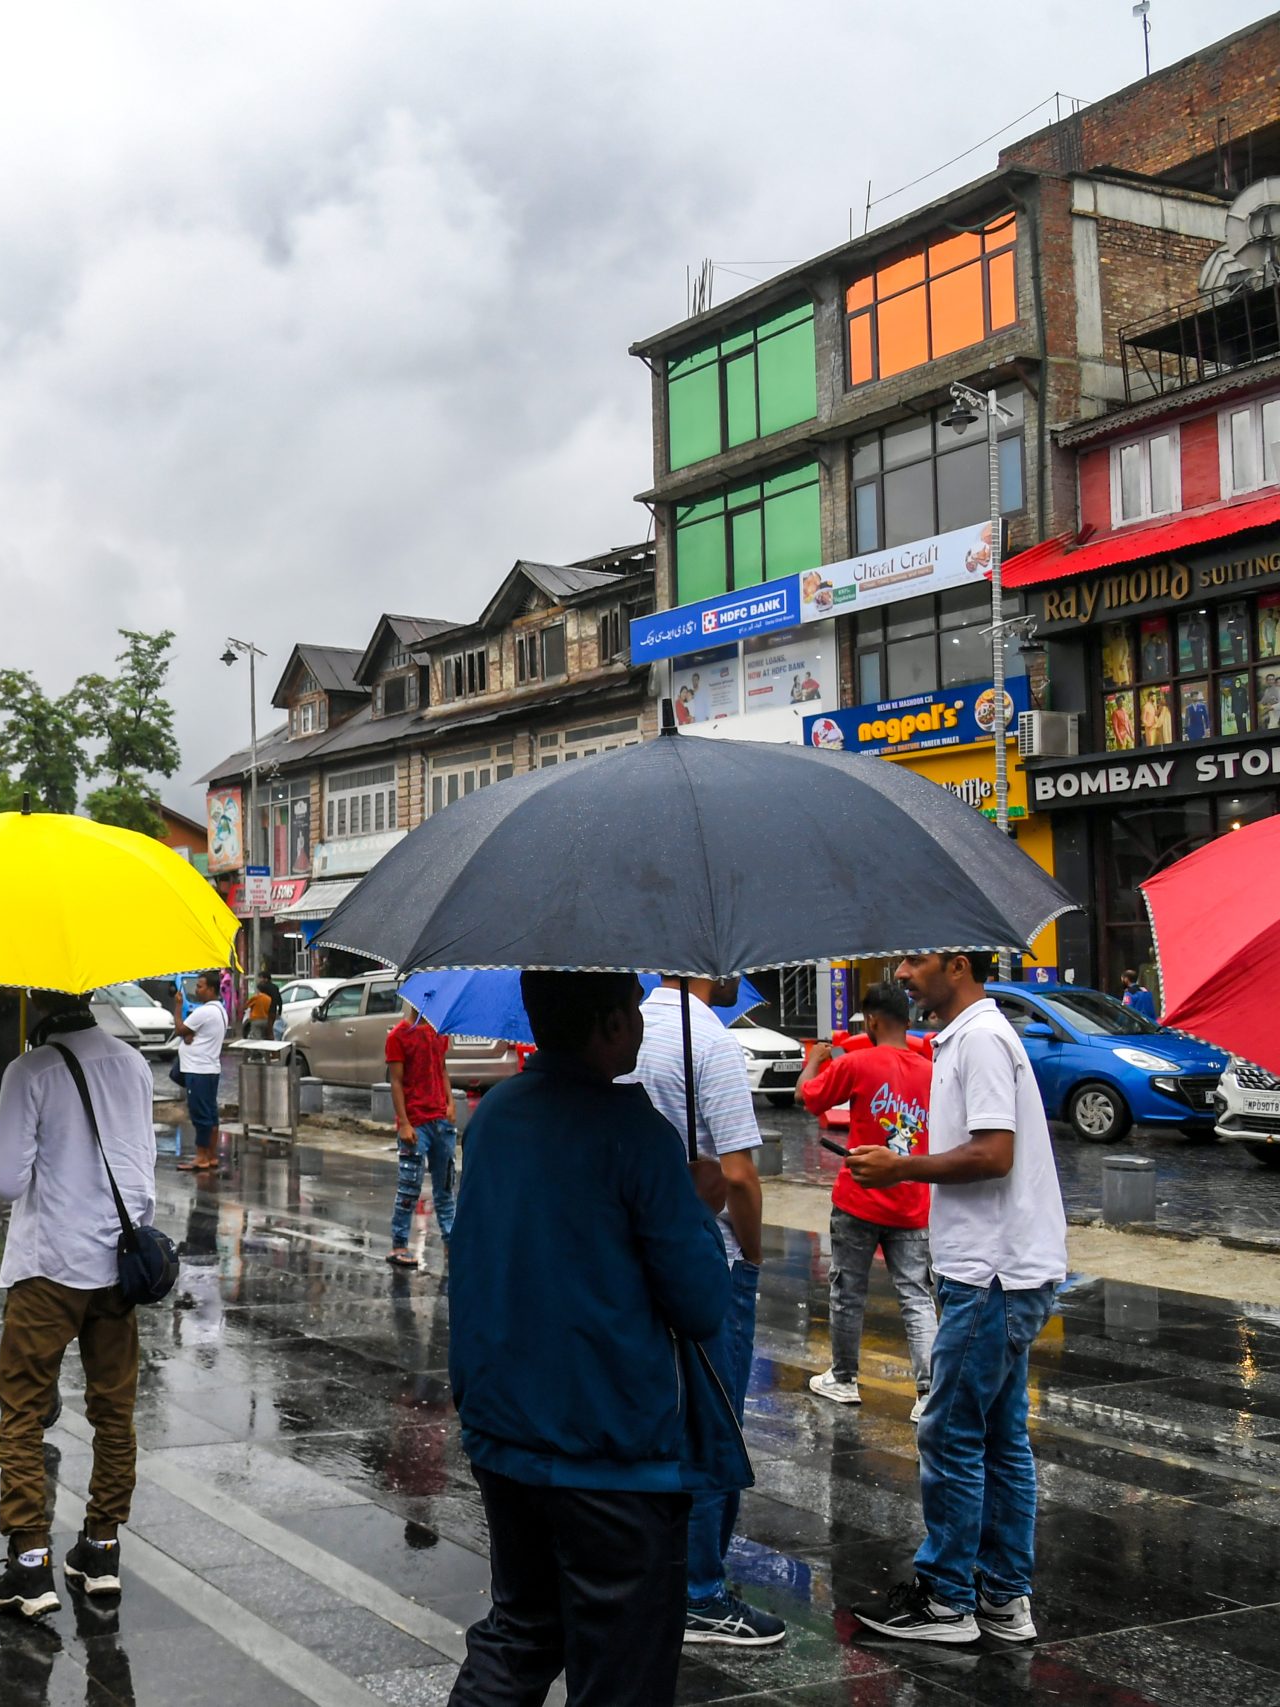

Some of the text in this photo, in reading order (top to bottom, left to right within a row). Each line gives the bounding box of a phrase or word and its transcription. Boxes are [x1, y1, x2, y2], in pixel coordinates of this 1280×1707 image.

[853, 557, 896, 582] Chaat
[900, 543, 939, 570] Craft
[720, 607, 748, 624] HDFC
[750, 598, 781, 616] BANK
[1041, 559, 1191, 624] Raymond
[771, 665, 788, 676] HDFC
[788, 661, 806, 672] BANK
[857, 702, 958, 744] nagpal's
[1034, 746, 1280, 801] BOMBAY STO
